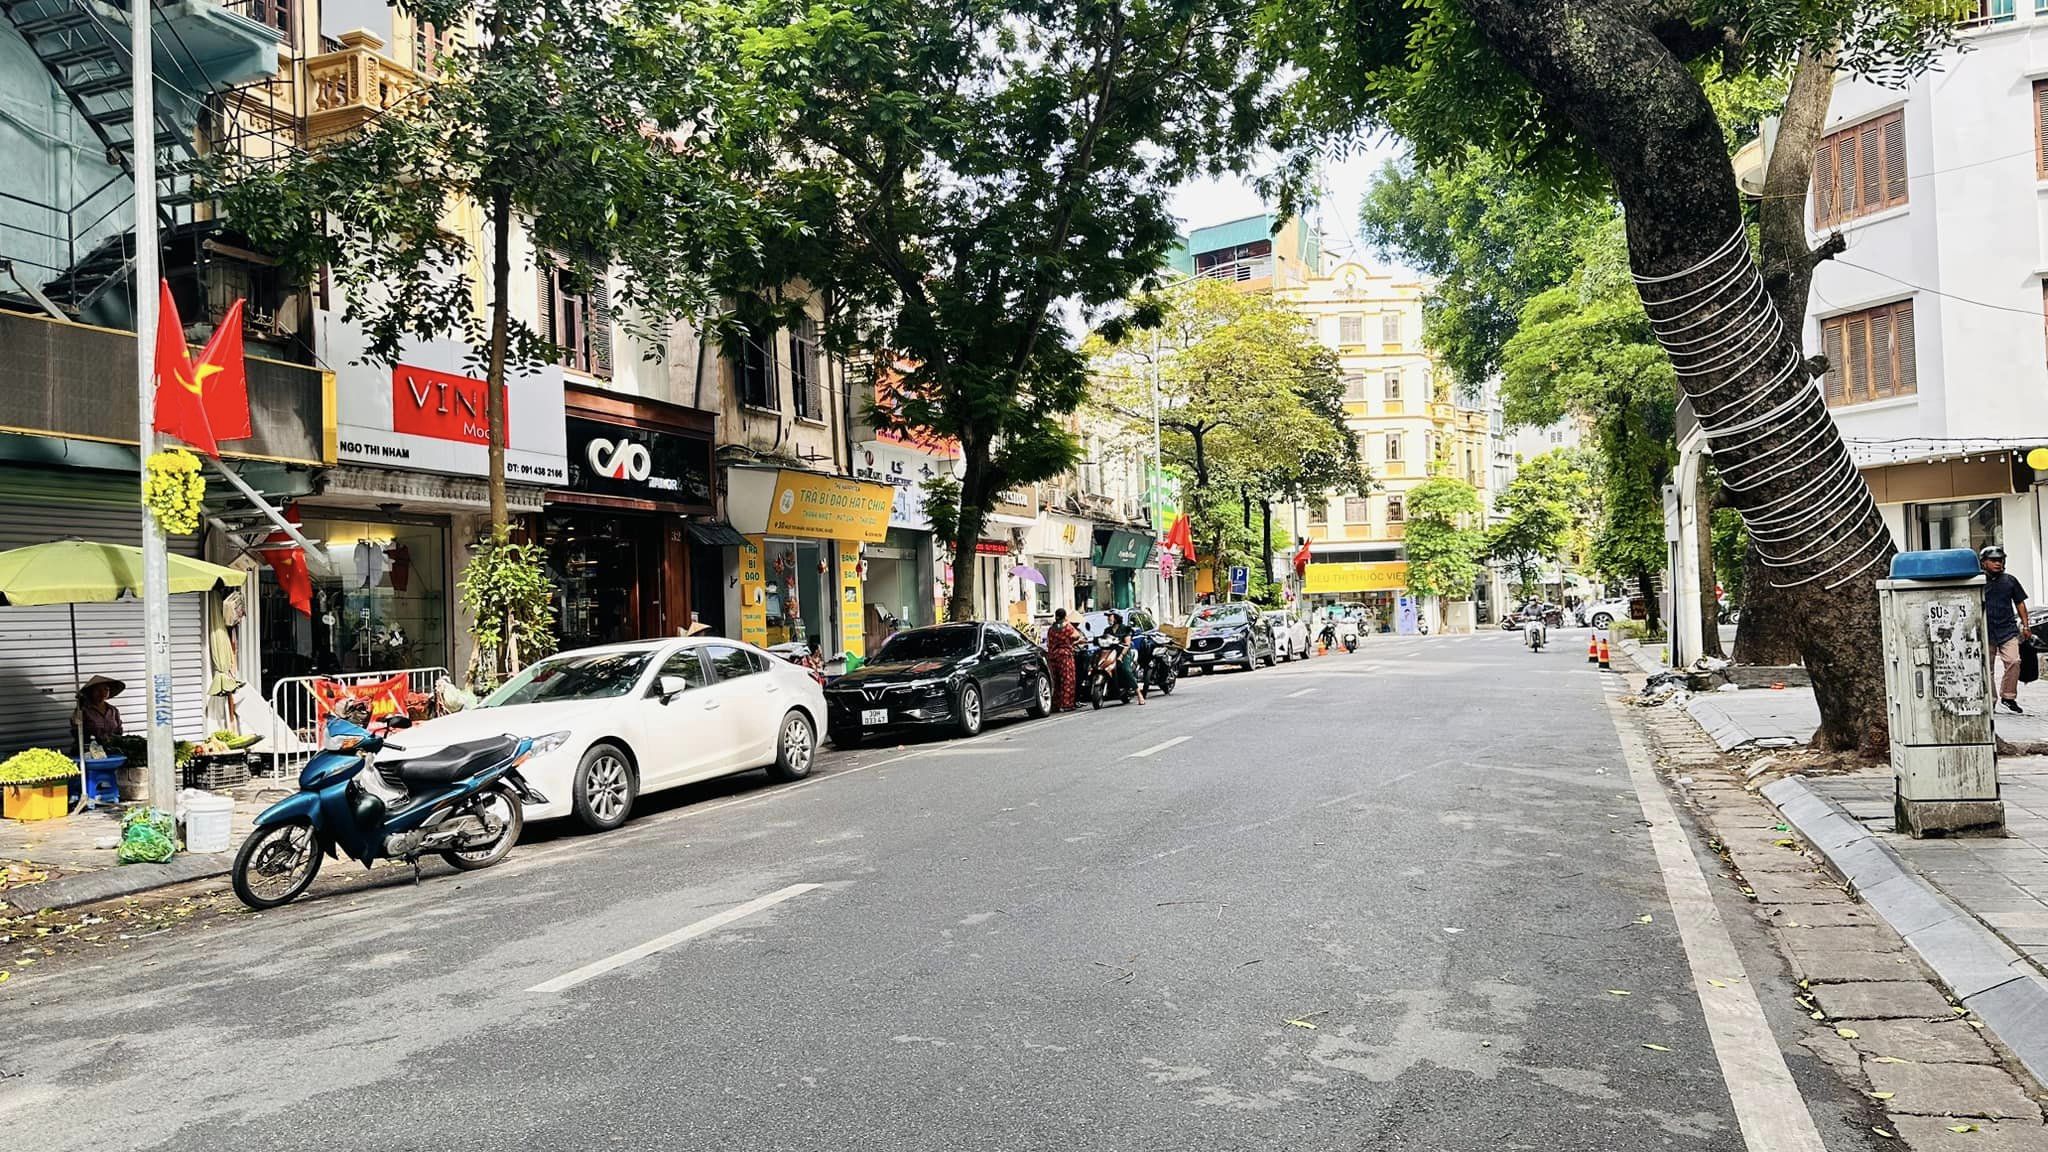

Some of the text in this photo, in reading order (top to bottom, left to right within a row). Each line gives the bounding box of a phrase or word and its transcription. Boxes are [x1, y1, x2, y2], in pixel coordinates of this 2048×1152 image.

[406, 375, 490, 421] VIN
[585, 438, 651, 481] CAO
[891, 460, 904, 475] LS
[800, 486, 817, 503] TRÀ
[1236, 569, 1244, 580] P
